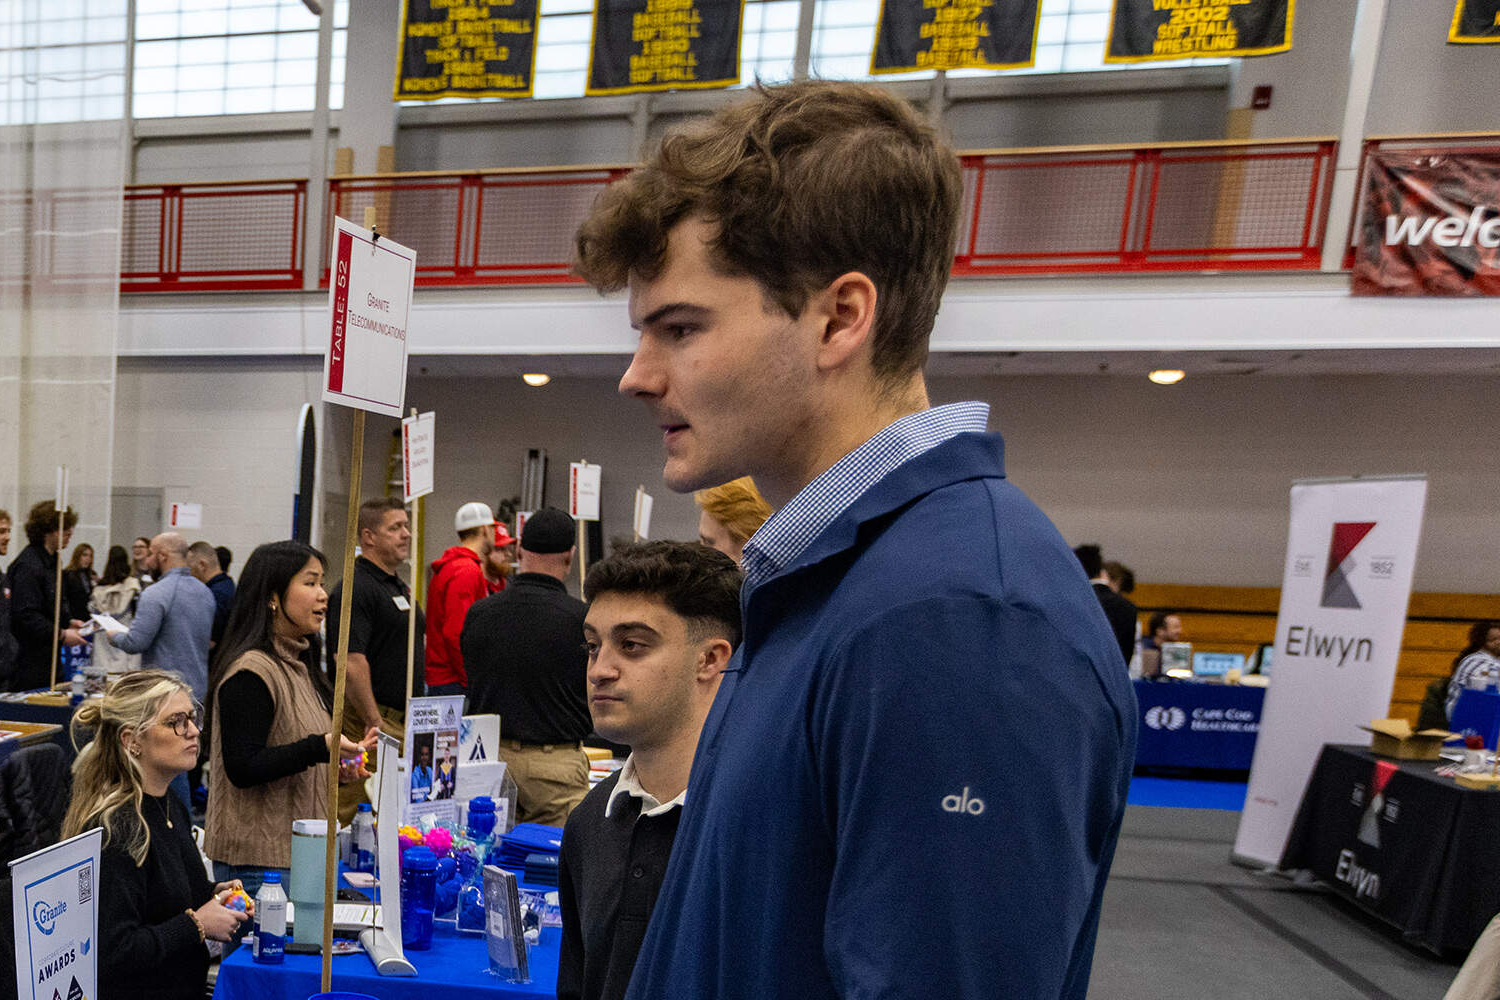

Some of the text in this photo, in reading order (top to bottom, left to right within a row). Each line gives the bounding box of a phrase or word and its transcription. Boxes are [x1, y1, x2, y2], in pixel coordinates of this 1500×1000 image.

[1156, 19, 1239, 41] SOFTBALL
[1169, 5, 1230, 25] 2002
[1152, 33, 1238, 55] WRESTLING
[1384, 205, 1500, 248] welc
[332, 259, 349, 366] TABLE: 52
[366, 292, 390, 314] GRANITE
[1285, 625, 1374, 669] Elwyn
[940, 785, 985, 816] alo
[1335, 848, 1380, 900] Elwyn
[38, 899, 68, 925] Granite
[38, 948, 77, 985] AWARDS
